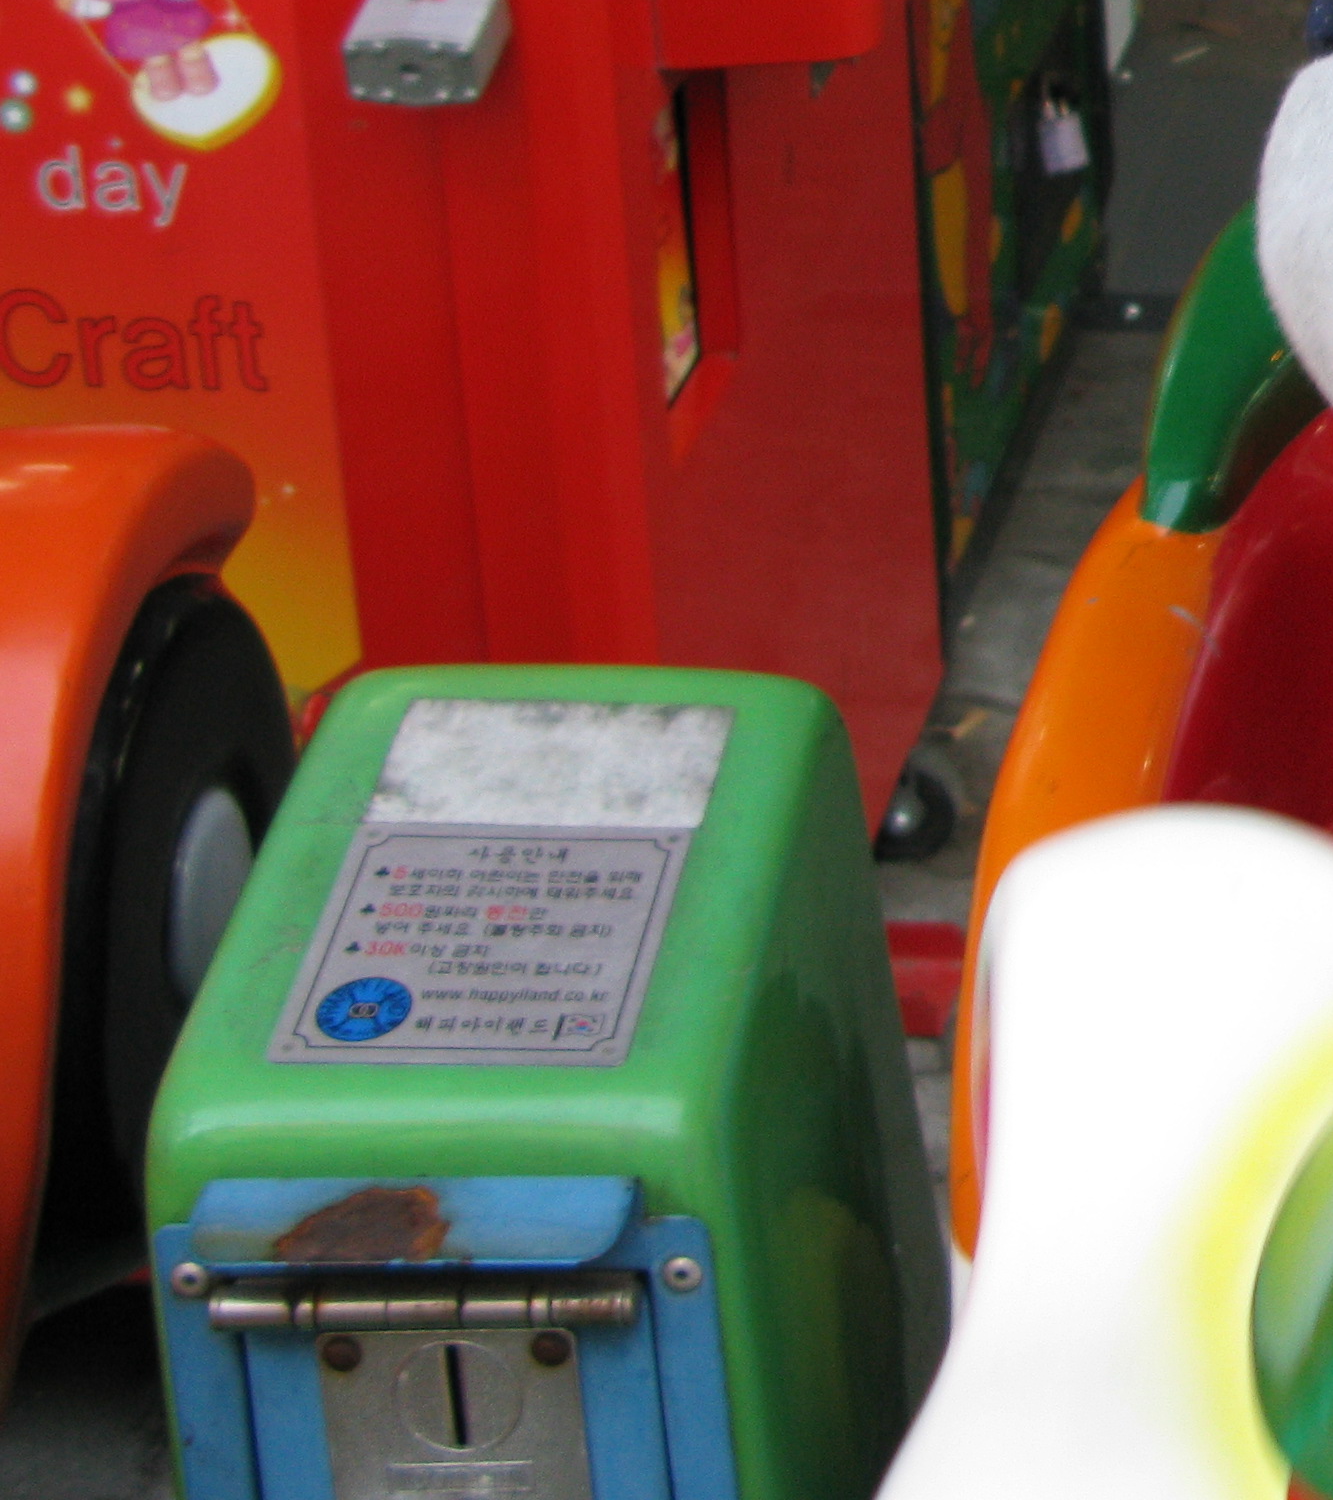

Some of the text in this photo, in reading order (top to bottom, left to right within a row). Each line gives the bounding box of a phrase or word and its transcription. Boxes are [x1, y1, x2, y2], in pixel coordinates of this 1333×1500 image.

[36, 145, 188, 228] day
[0, 288, 270, 392] Craft
[468, 845, 570, 865] 사용안내
